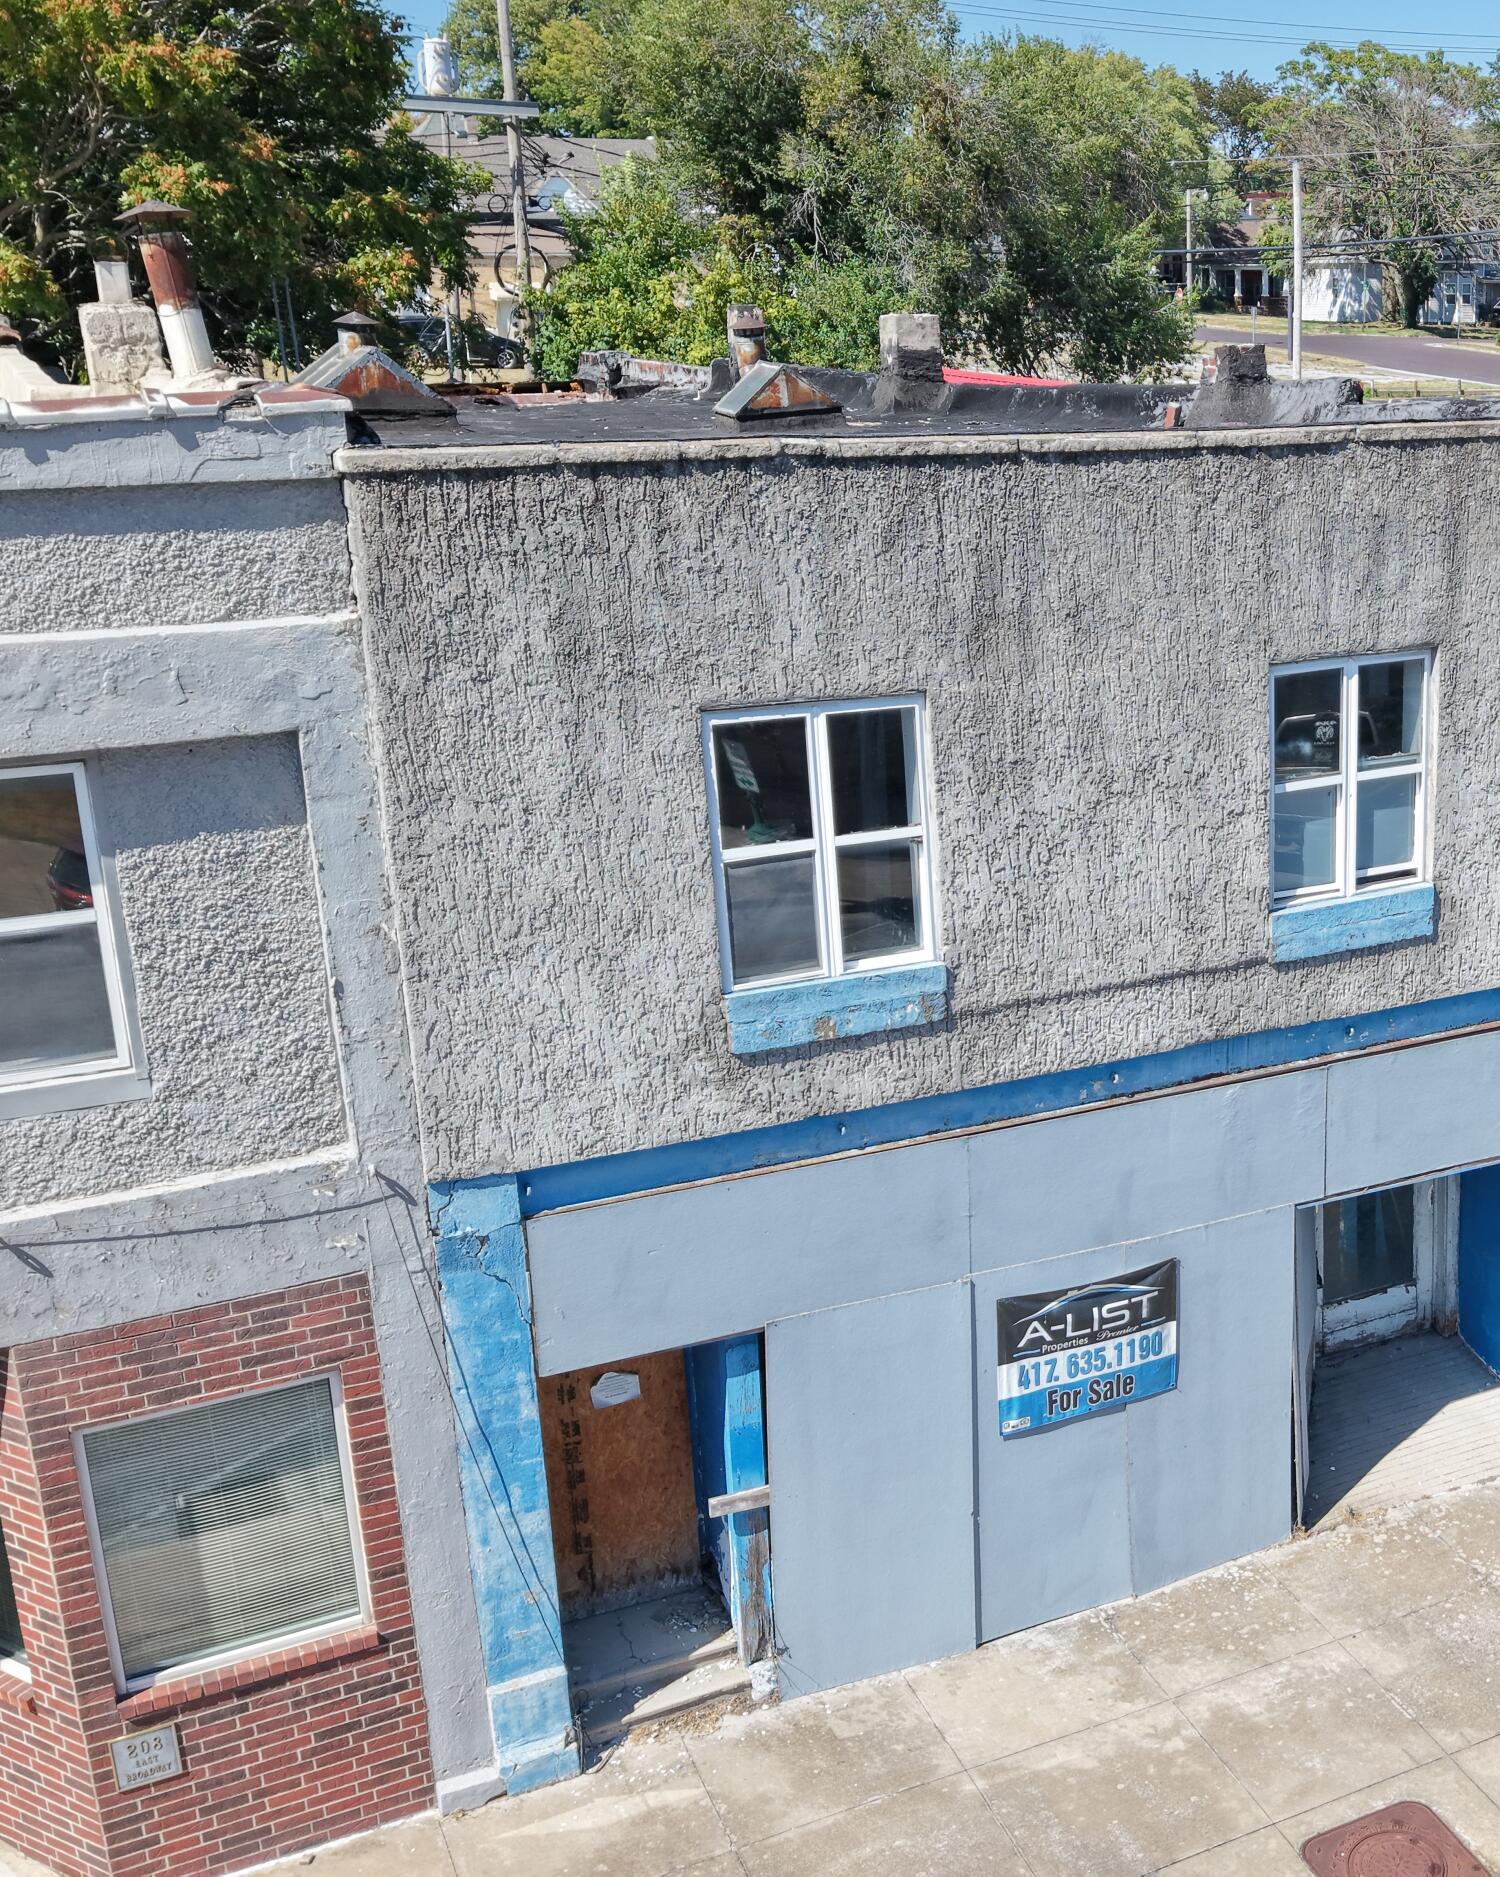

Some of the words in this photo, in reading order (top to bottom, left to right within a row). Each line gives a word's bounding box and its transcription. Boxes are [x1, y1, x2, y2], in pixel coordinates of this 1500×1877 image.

[1017, 1291, 1158, 1348] A-LIST
[1042, 1336, 1088, 1354] Properties
[1096, 1324, 1140, 1341] Premier
[1047, 1388, 1081, 1416] For
[1088, 1373, 1135, 1405] Sale
[127, 1736, 163, 1760] 208
